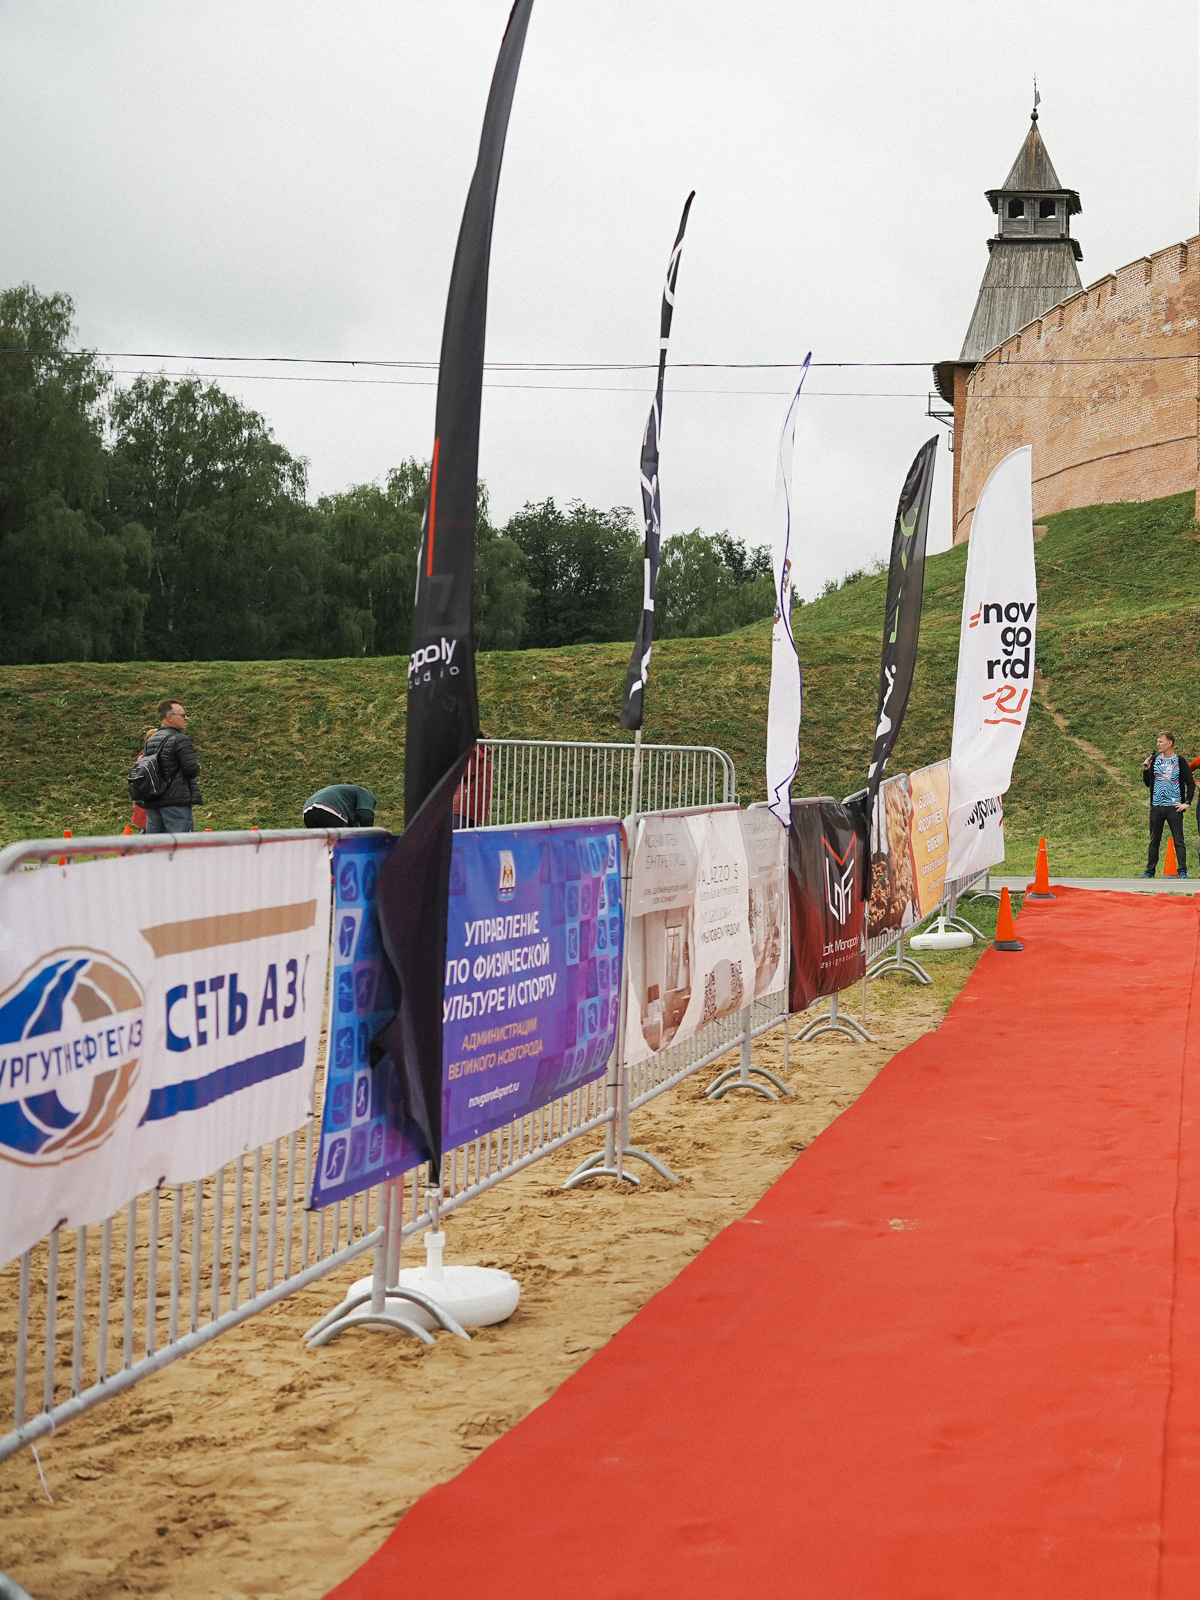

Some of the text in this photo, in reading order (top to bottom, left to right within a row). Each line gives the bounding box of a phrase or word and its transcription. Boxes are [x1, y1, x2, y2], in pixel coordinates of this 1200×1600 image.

[1001, 626, 1032, 656] go
[464, 911, 540, 947] УПРАВЛЕНИЕ
[445, 937, 550, 986] ПО ФИЗИЧЕСКОЙ
[165, 954, 310, 1053] СЕТЬ АЗ
[442, 972, 557, 1024] УЛЬТУРЕ И СПОРТУ
[461, 1017, 538, 1052] АДМИНИСТРАЦИИ
[448, 1038, 544, 1080] ВЕЛИКОГО НОВГОРОДА
